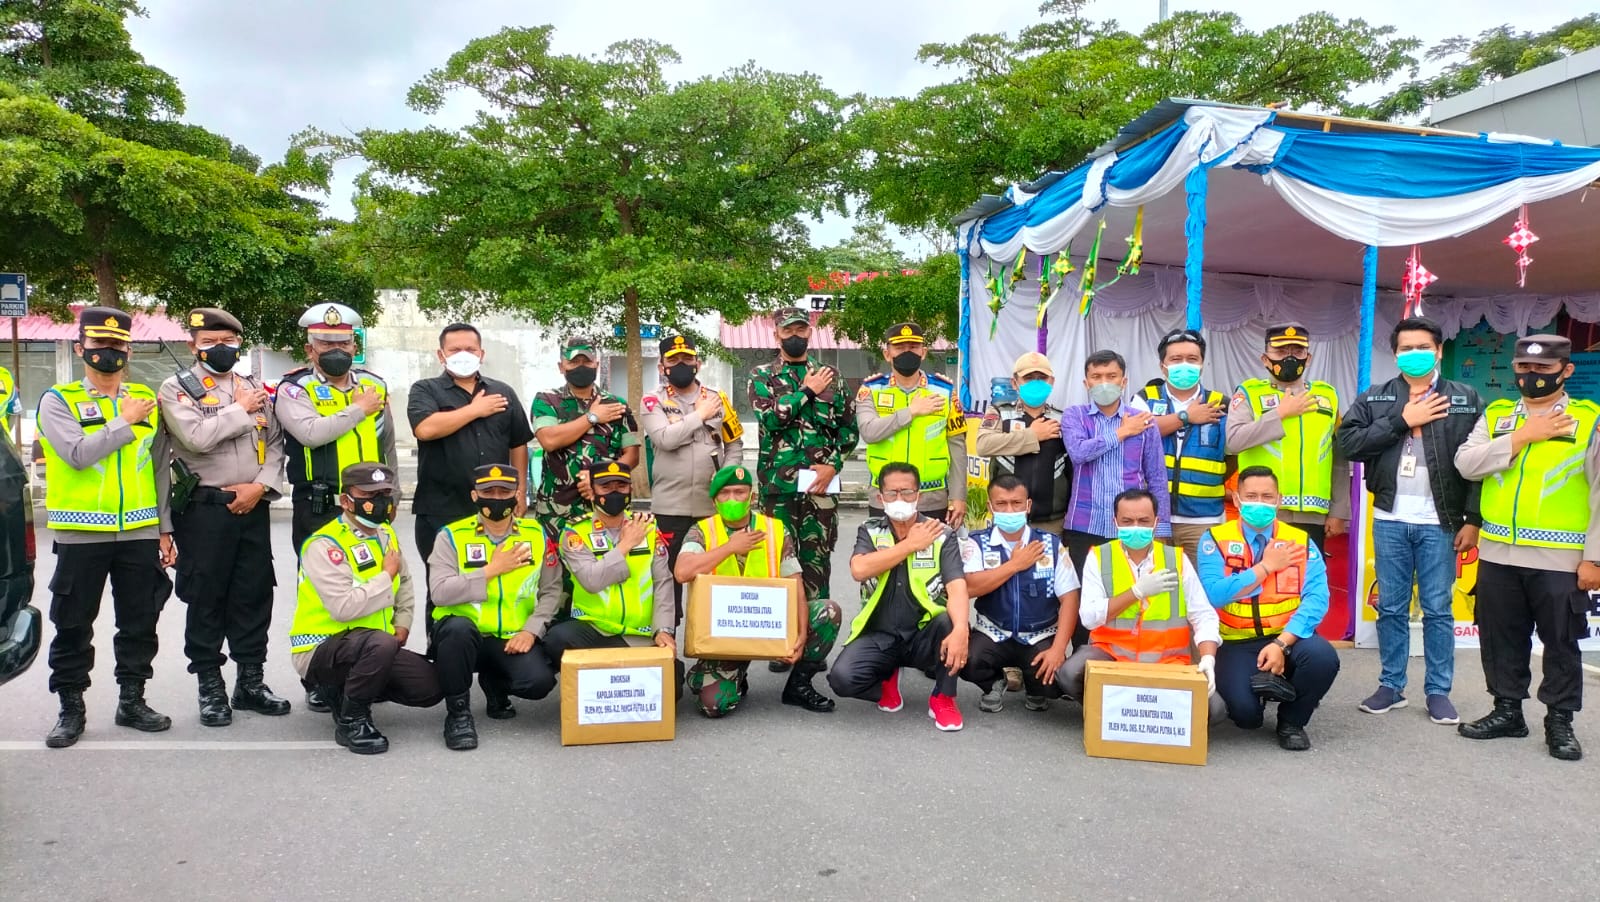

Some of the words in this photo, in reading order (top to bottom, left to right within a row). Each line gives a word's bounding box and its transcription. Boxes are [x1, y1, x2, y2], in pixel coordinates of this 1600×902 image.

[17, 275, 24, 284] P
[596, 690, 613, 699] KAPOLDA
[613, 689, 632, 699] SUMATERA
[633, 689, 645, 697] UTARA
[1121, 708, 1138, 717] KAPOLDA
[1139, 709, 1160, 719] SUMATERA
[1160, 711, 1174, 720] UTARA
